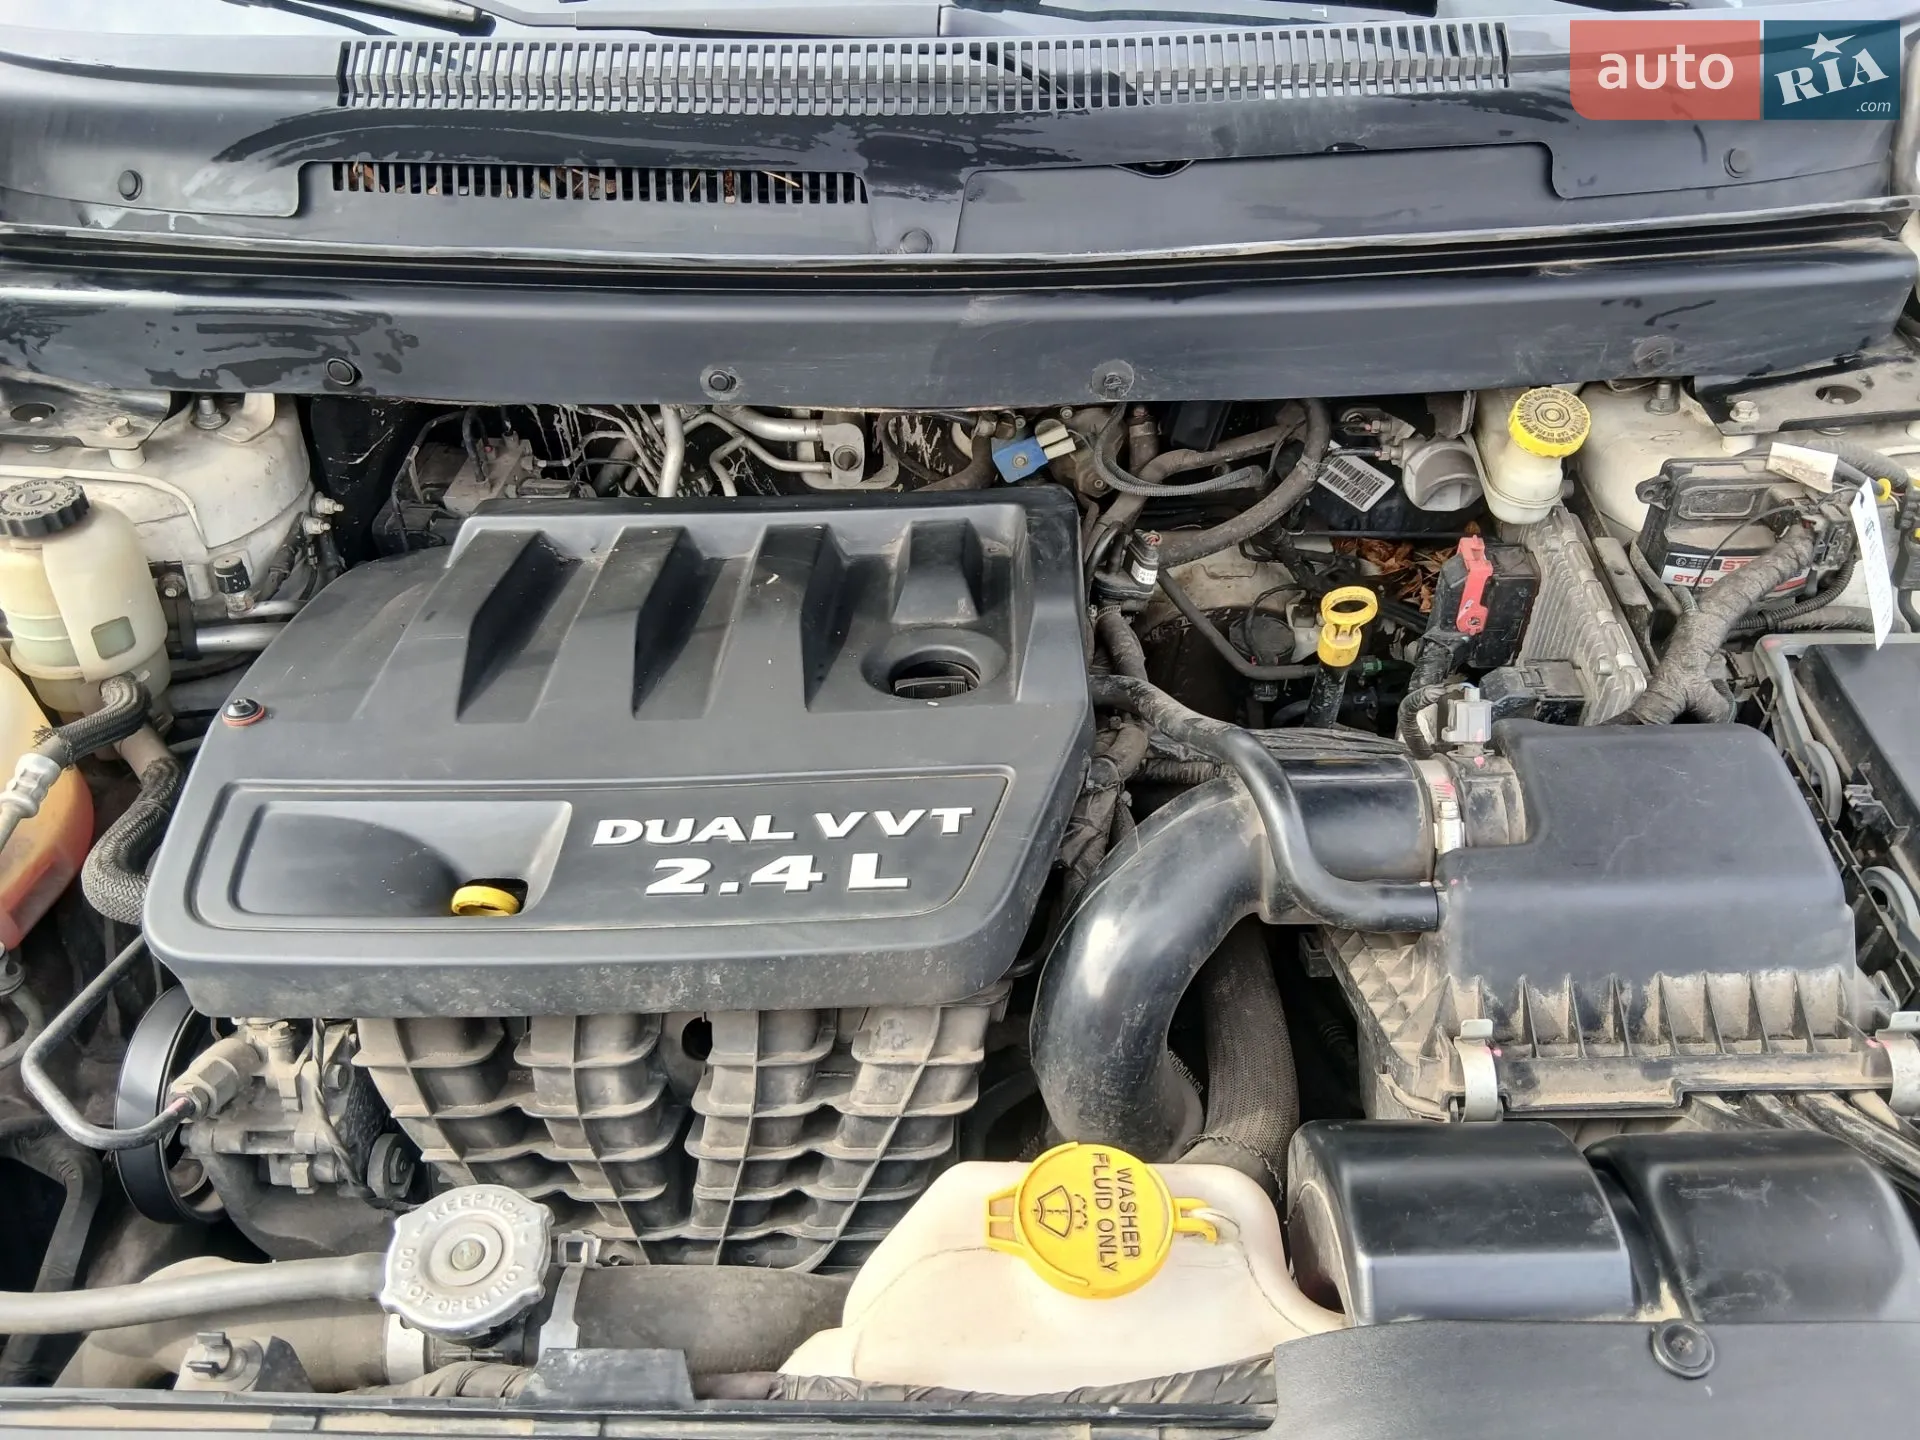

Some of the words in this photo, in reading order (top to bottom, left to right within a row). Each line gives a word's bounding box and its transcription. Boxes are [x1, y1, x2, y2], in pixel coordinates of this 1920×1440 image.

[1672, 574, 1715, 585] STAG
[592, 814, 797, 846] DUAL
[813, 806, 974, 840] VVT
[645, 853, 825, 897] 2.4
[847, 852, 912, 892] L
[1092, 1152, 1113, 1211] FLUID
[427, 1192, 486, 1222] KEEP
[1116, 1167, 1142, 1259] WASHER
[1096, 1218, 1120, 1274] ONLY
[437, 1291, 492, 1314] OPEN
[490, 1259, 526, 1298] HOT
